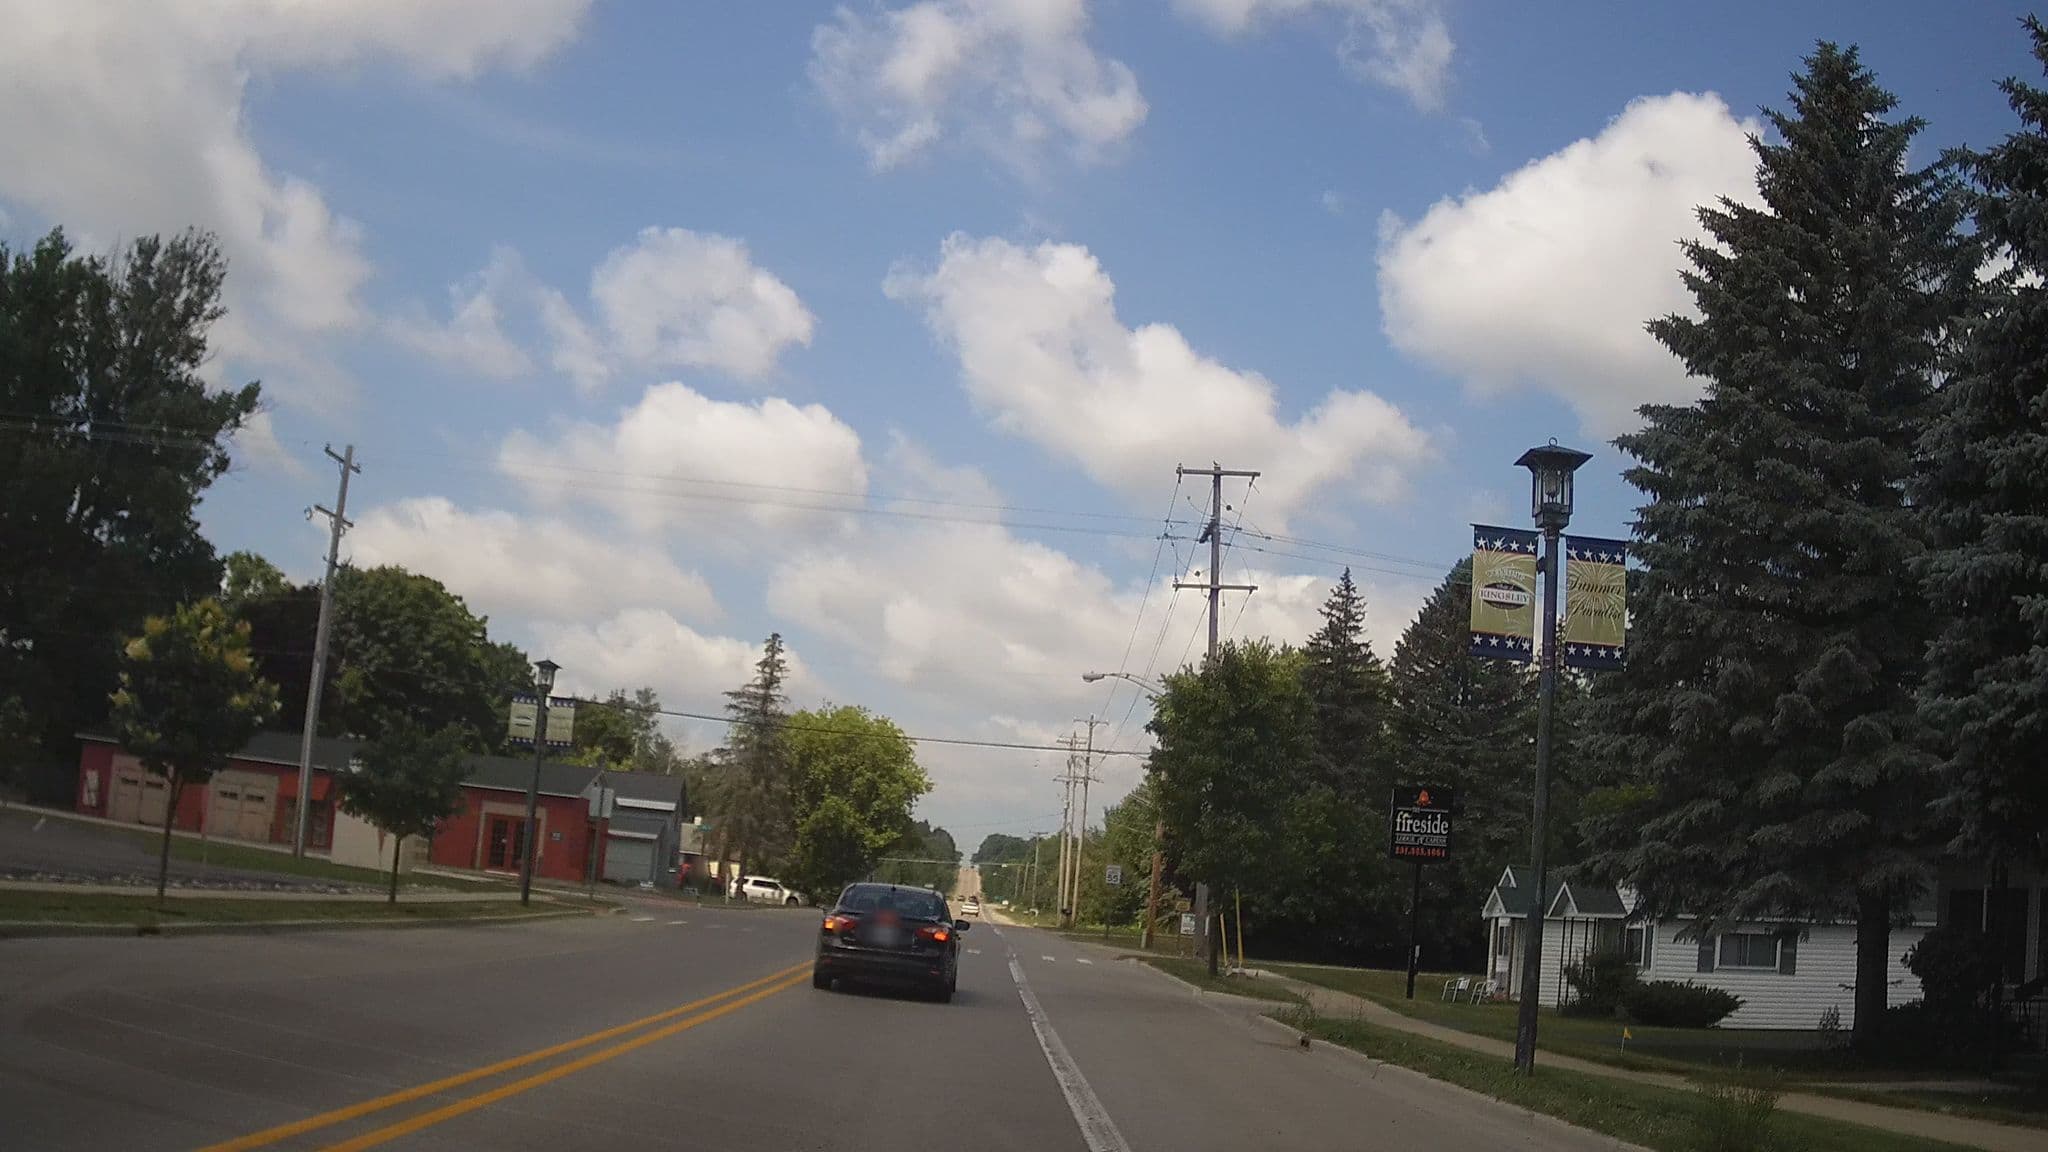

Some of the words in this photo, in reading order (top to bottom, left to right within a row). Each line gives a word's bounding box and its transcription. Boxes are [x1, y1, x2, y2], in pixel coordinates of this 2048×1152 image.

[1569, 575, 1624, 595] Summer
[1481, 590, 1528, 603] KINGSLEY
[1571, 600, 1621, 619] Paradise
[1395, 811, 1448, 834] fireside
